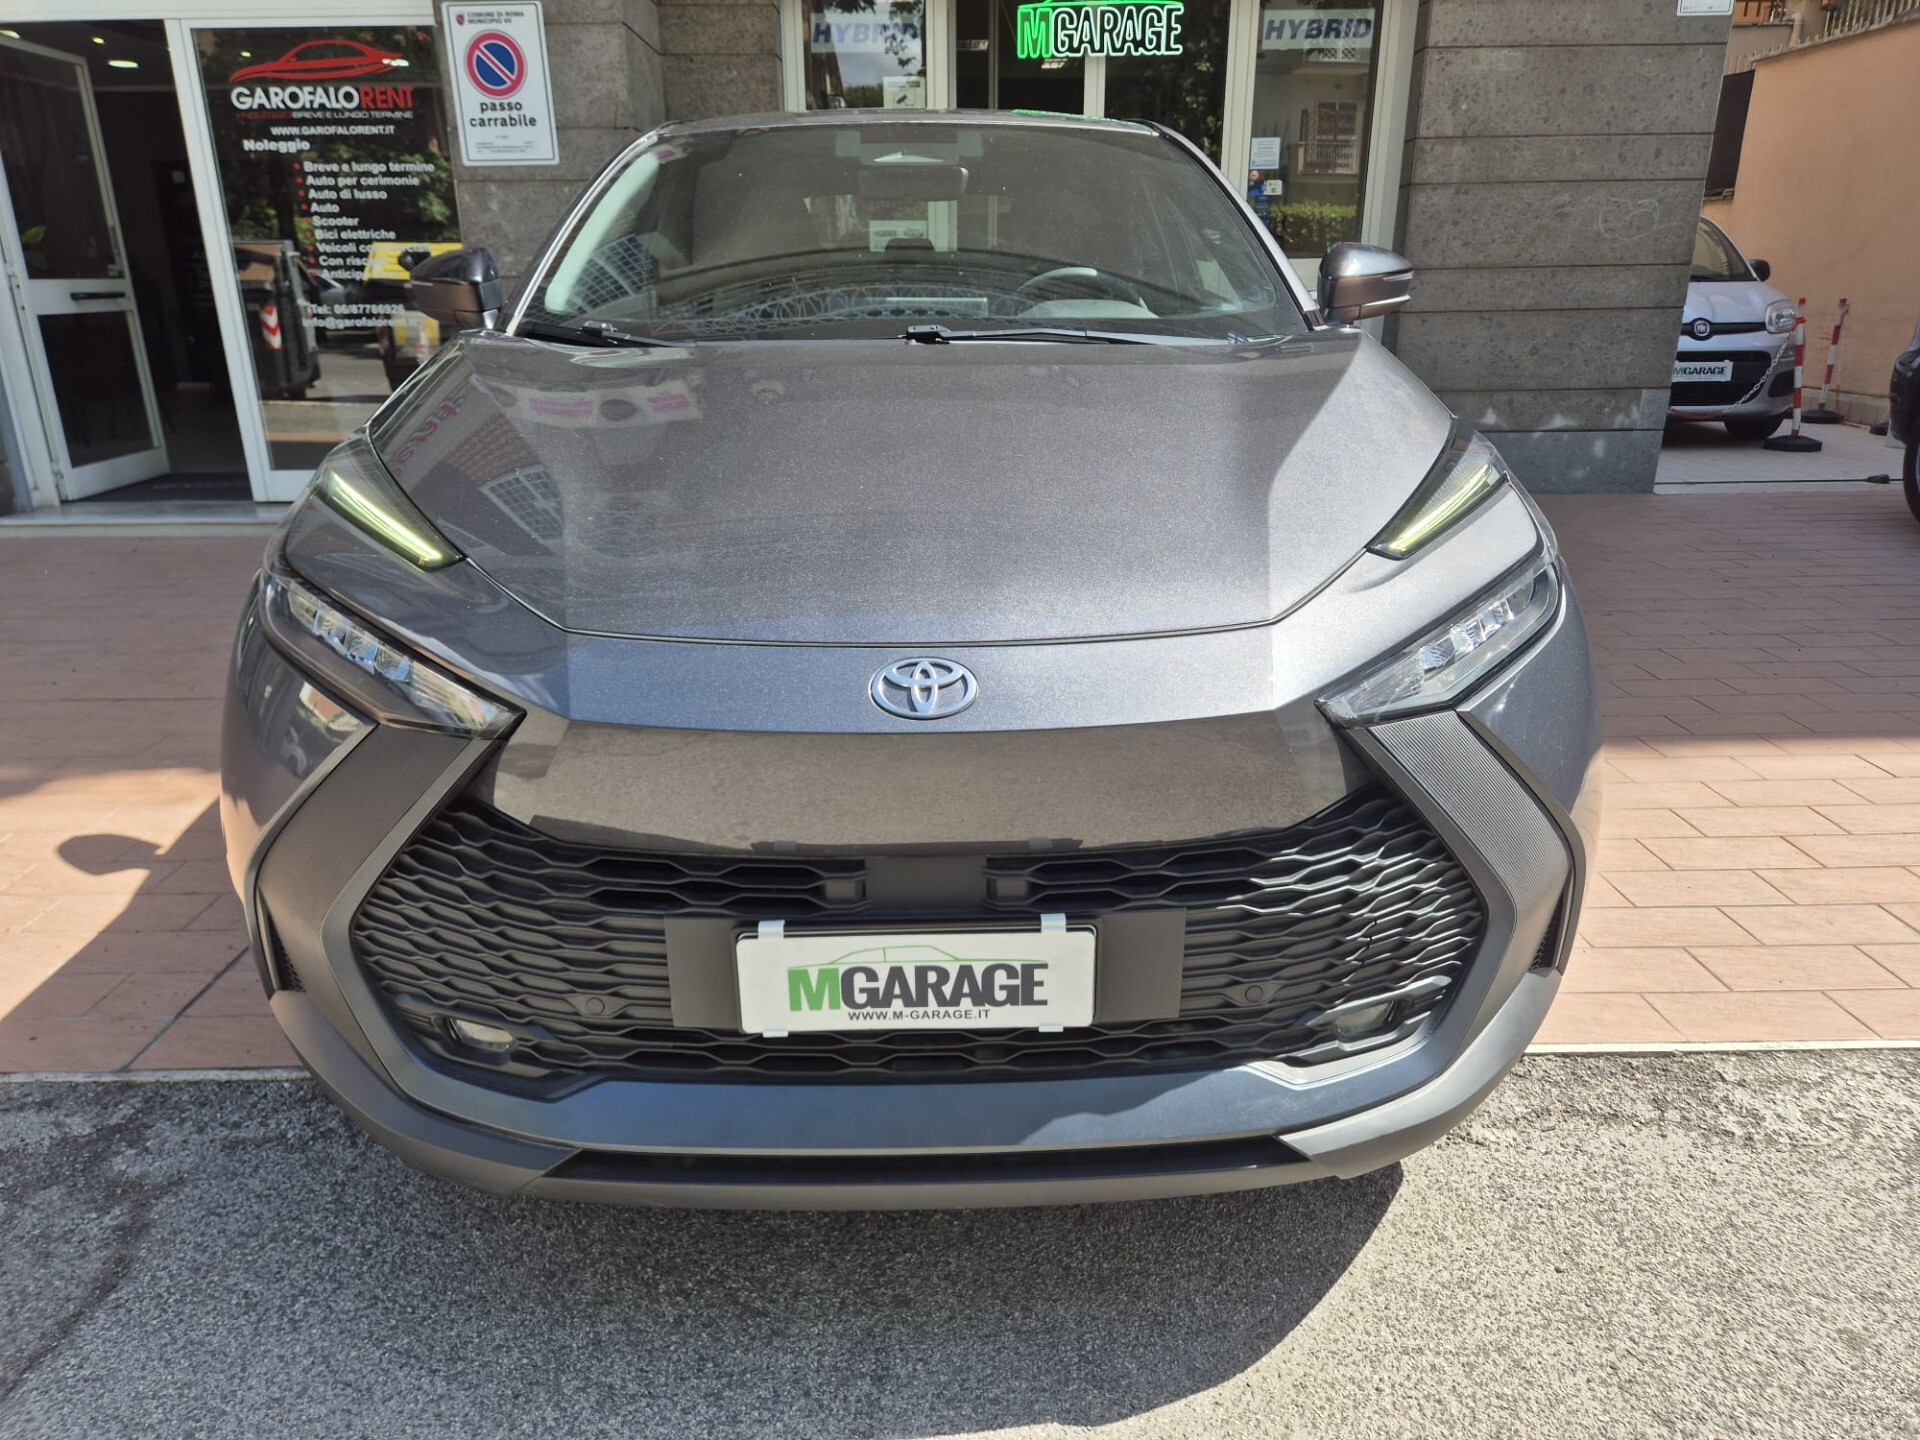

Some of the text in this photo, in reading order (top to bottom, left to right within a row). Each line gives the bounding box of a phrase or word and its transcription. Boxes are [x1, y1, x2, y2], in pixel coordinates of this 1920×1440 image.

[1017, 5, 1184, 59] MGARAGE
[1265, 18, 1372, 40] HYBRID
[480, 102, 523, 114] passo
[370, 111, 414, 119] TERMINE
[469, 114, 537, 127] carrabile
[270, 125, 395, 136] WWW.GAROFALORENT.IT
[242, 139, 311, 153] Noleggio
[303, 161, 435, 174] Breve e lungo termine
[306, 174, 420, 188] Auto per cerimonie
[308, 188, 388, 200] Auto di lusso
[310, 202, 340, 213] Auto
[311, 215, 360, 227] Scooter
[314, 228, 396, 240] Bici elettriche
[315, 242, 357, 253] Veicoli
[319, 255, 344, 266] Con
[786, 962, 1049, 1012] MGARAGE
[847, 1008, 992, 1022] WWW.M-GARAGE.IT
